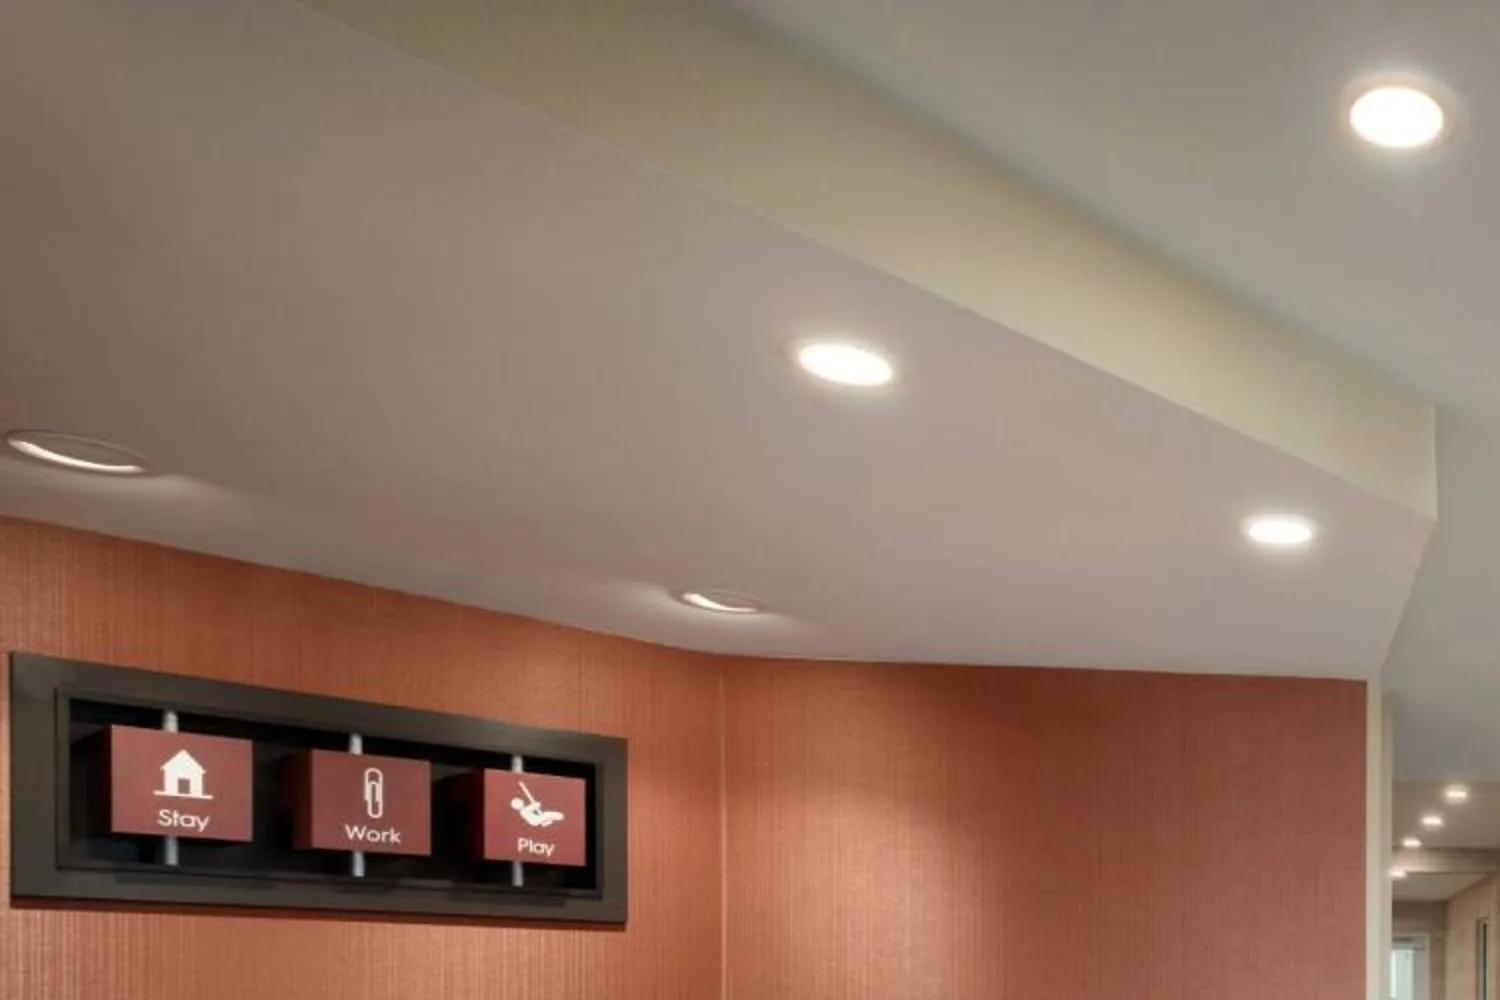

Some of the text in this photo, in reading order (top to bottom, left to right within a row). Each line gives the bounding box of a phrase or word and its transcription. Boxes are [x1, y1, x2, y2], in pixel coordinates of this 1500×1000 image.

[158, 808, 210, 833] Stay
[345, 823, 402, 845] Work
[517, 837, 555, 857] Play
